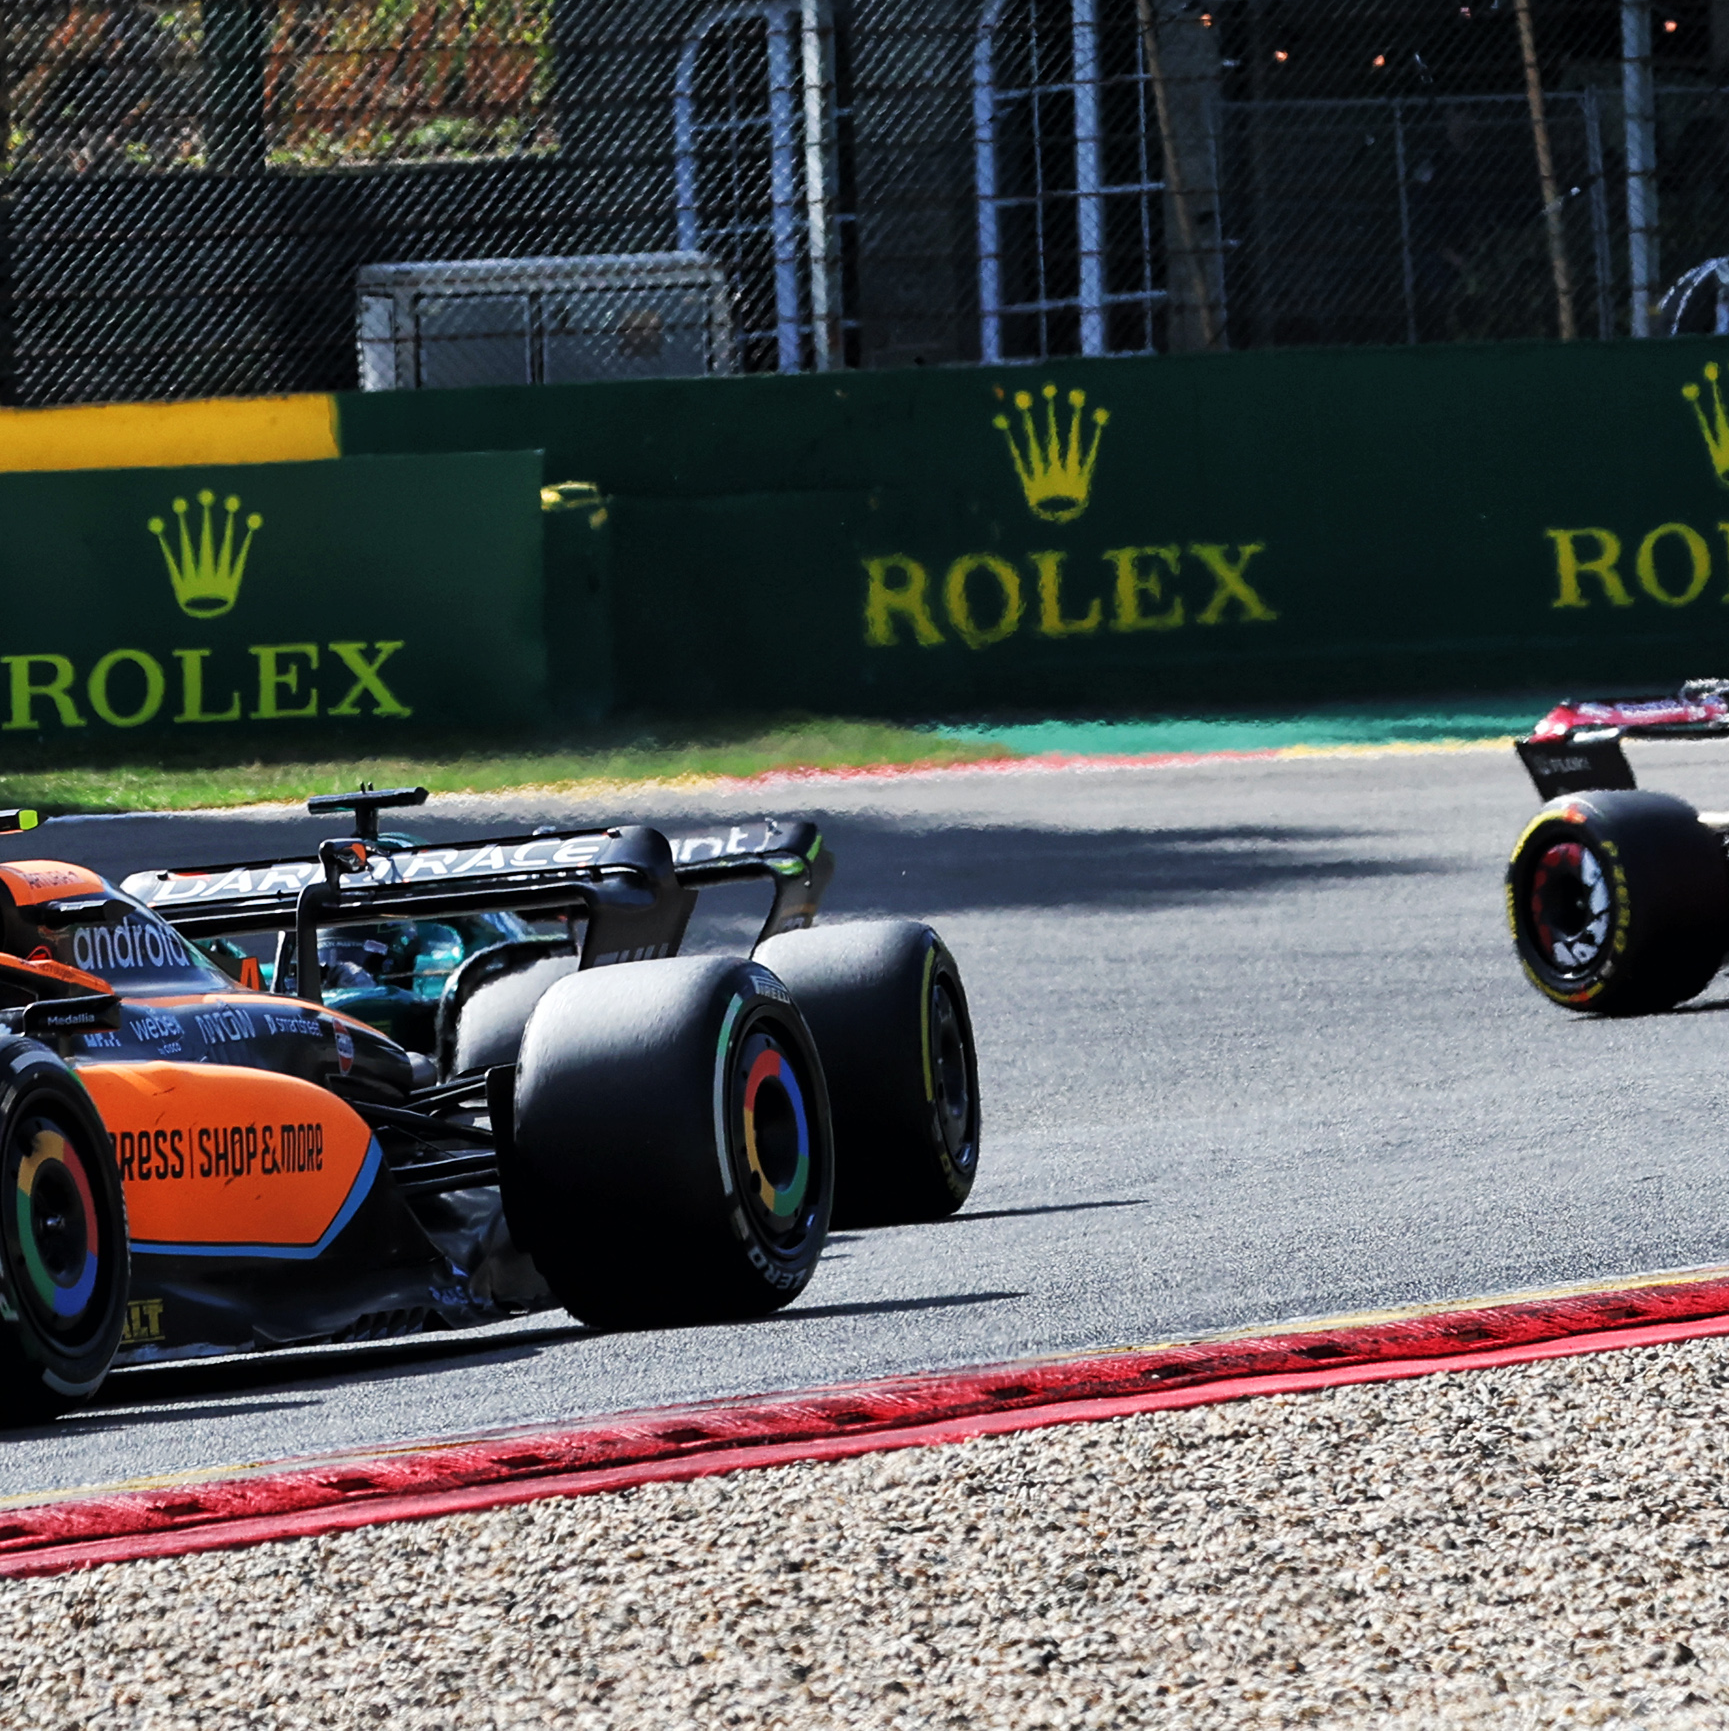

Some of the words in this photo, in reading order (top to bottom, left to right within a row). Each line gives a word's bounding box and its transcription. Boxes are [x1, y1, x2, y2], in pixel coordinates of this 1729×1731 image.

[866, 544, 1272, 647] ROLEX
[2, 642, 410, 732] ROLEX
[73, 917, 191, 971] android
[47, 1012, 95, 1027] Medallia
[129, 1015, 185, 1042] webex
[198, 1123, 257, 1178] SHOP
